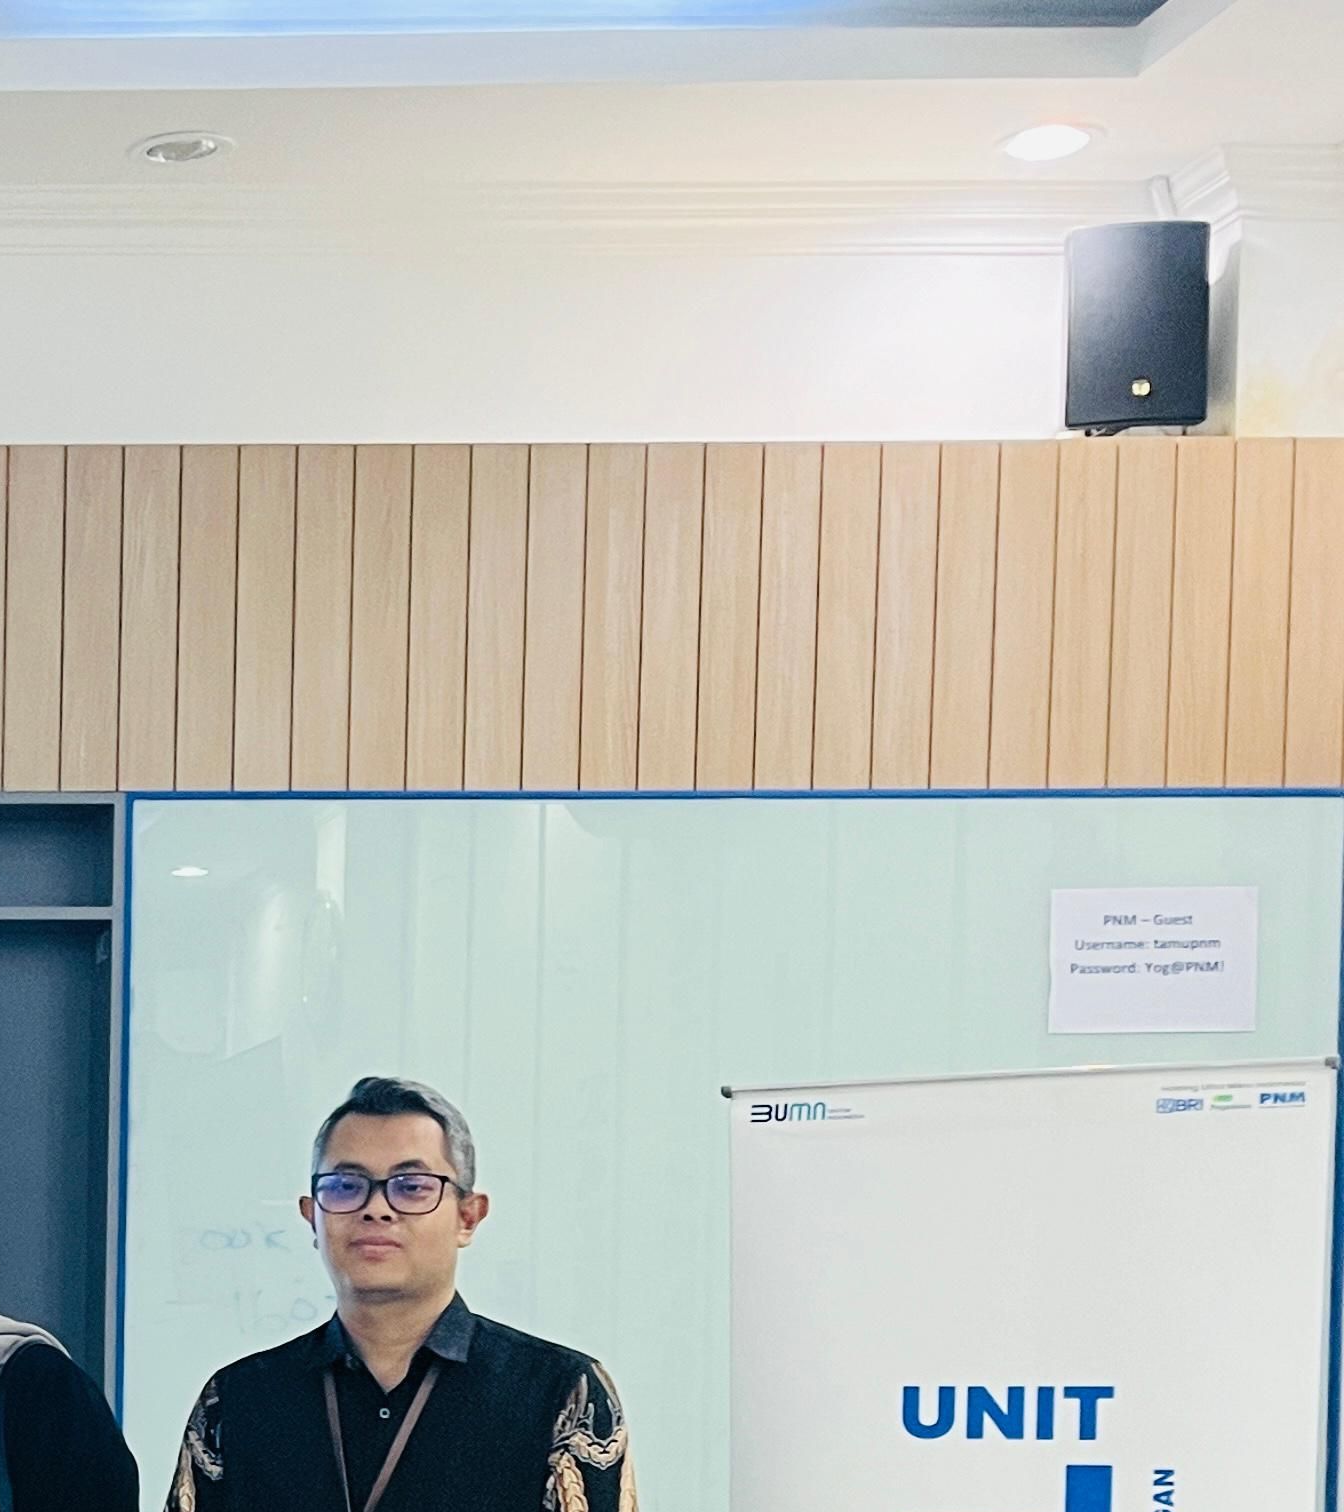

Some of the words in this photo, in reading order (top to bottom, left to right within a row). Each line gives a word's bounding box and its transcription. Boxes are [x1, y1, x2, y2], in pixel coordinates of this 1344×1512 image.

[1103, 914, 1137, 926] PNM
[1153, 914, 1193, 926] Guest
[1070, 962, 1140, 974] Password:
[1259, 1091, 1306, 1106] PNM
[902, 1385, 1115, 1440] UNIT
